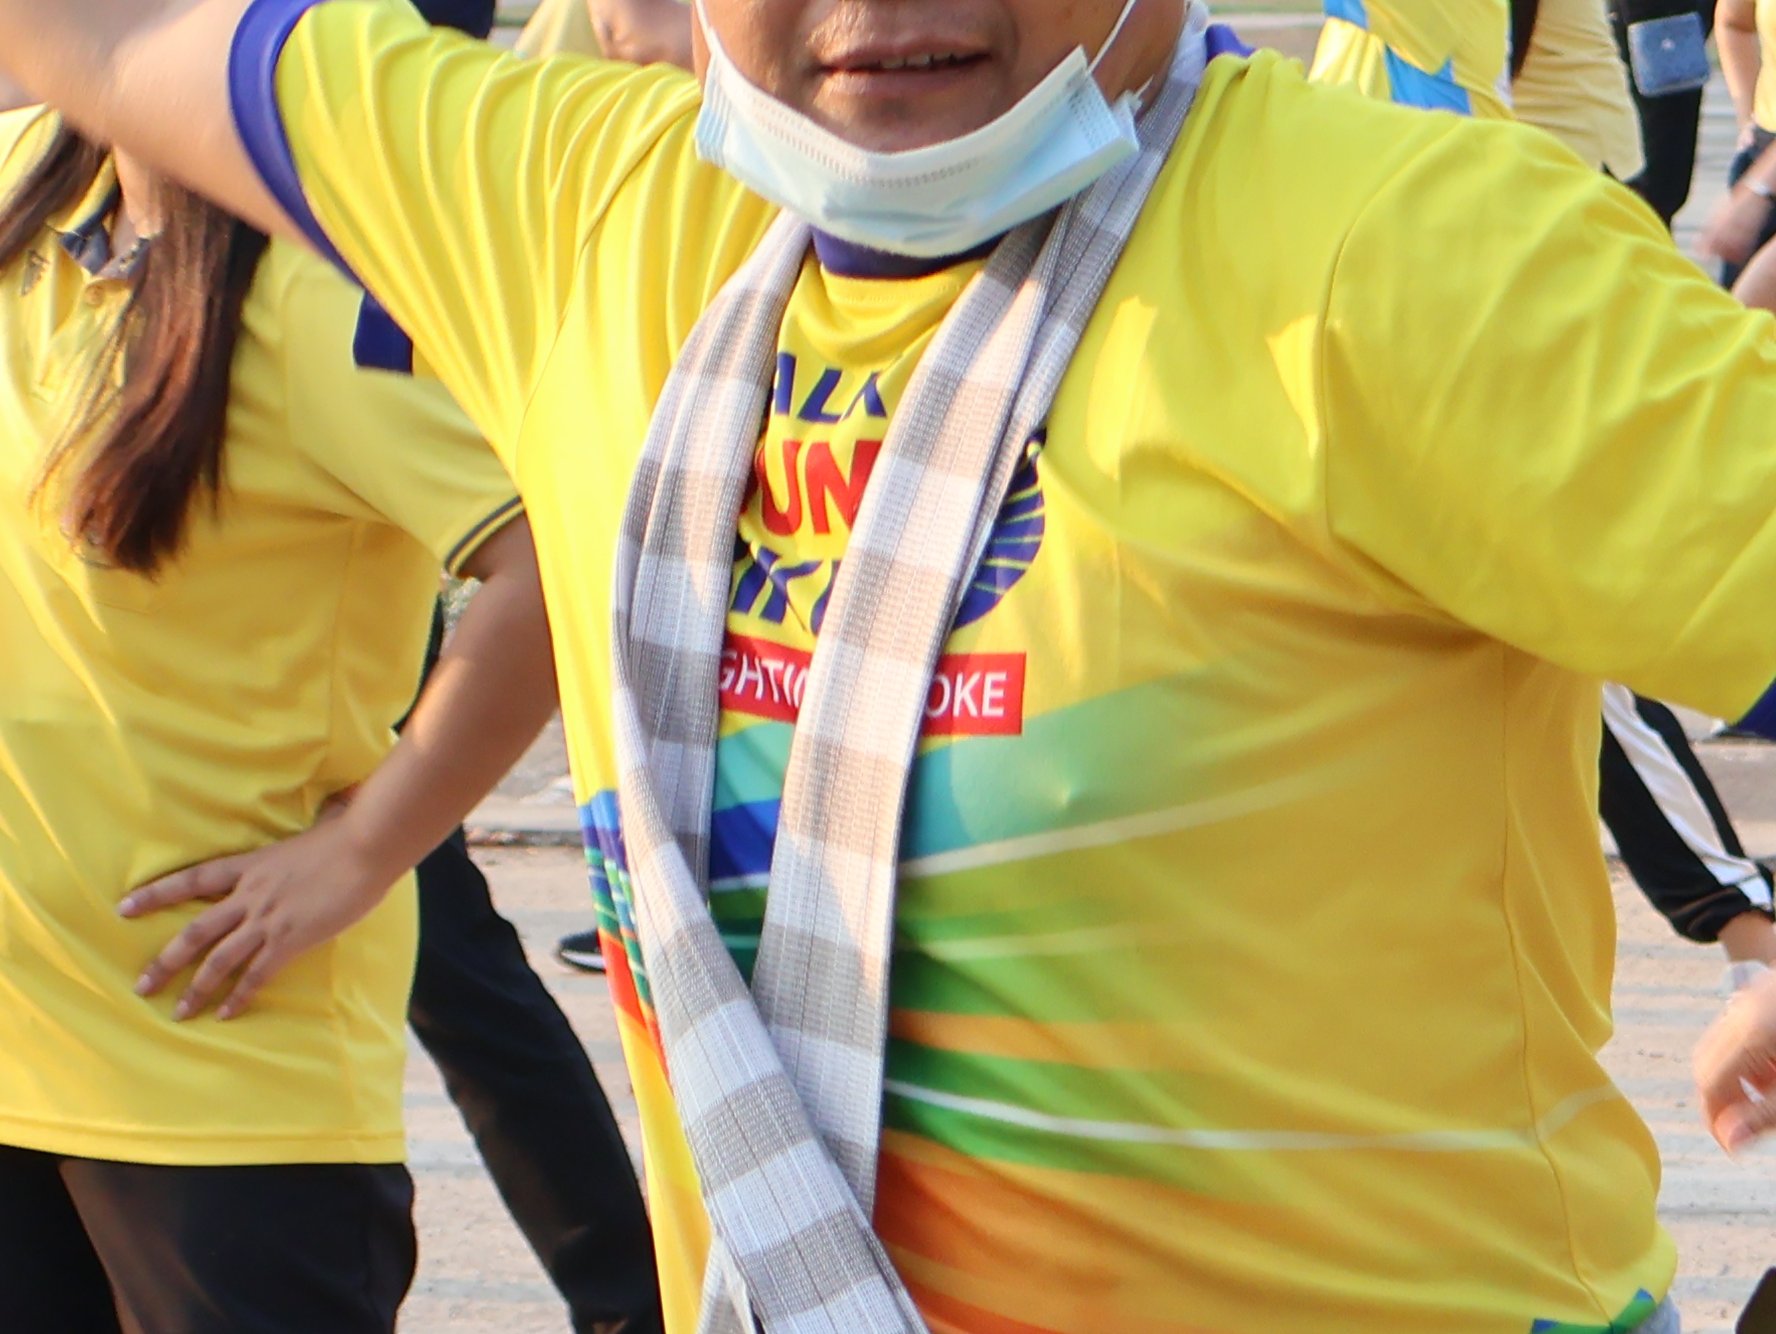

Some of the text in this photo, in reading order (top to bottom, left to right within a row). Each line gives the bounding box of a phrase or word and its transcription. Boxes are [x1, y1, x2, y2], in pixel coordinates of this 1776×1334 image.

[741, 439, 886, 537] UN
[719, 650, 1008, 718] GHTI OKE
